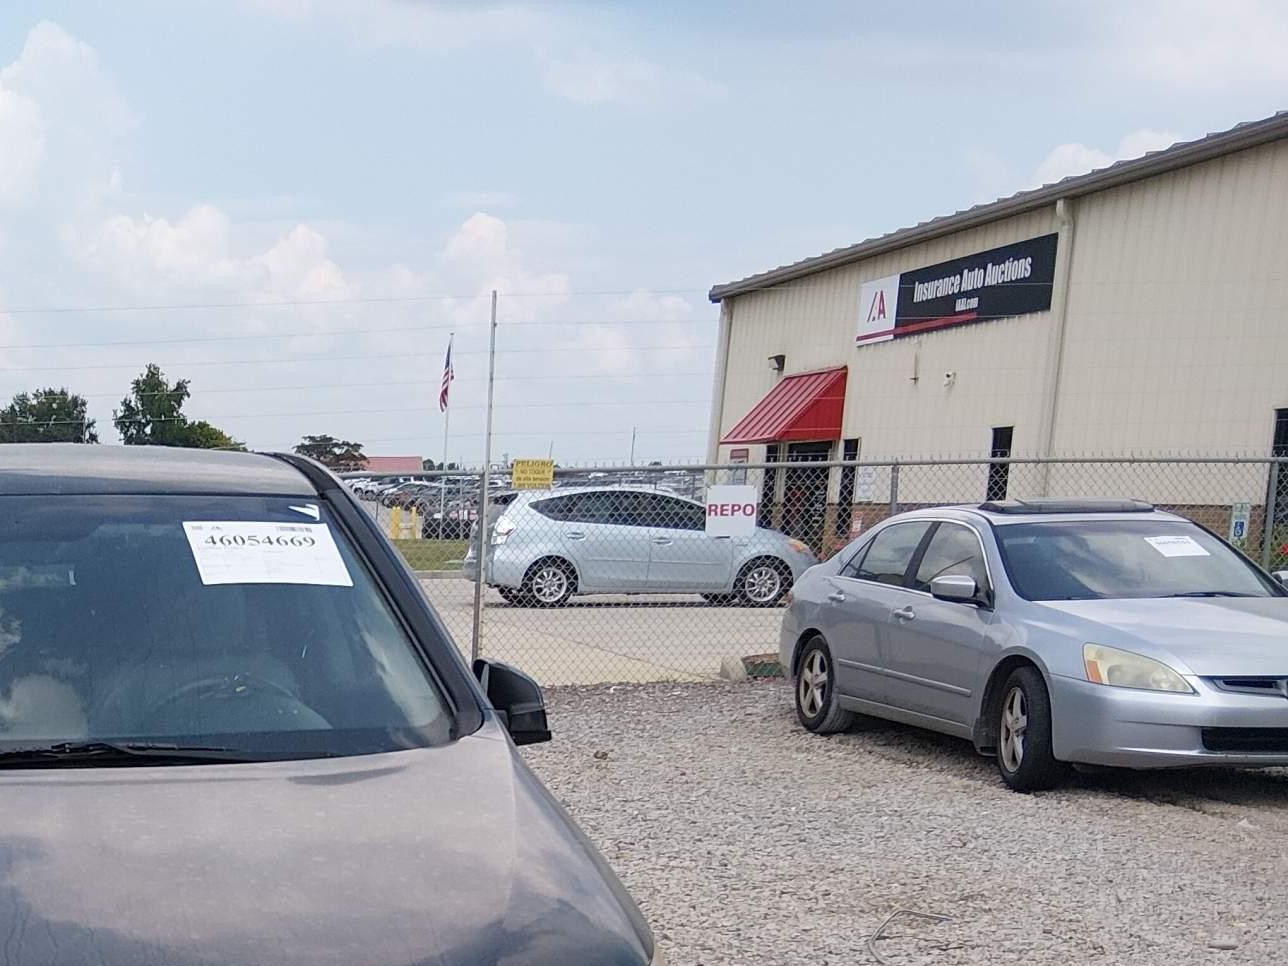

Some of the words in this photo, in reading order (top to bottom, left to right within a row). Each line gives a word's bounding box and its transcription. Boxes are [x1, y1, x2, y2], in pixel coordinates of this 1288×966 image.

[913, 274, 960, 303] Insurance
[960, 268, 985, 292] Auto
[984, 257, 1032, 287] Auctions
[707, 503, 755, 517] REPO
[205, 535, 316, 547] 46054669
